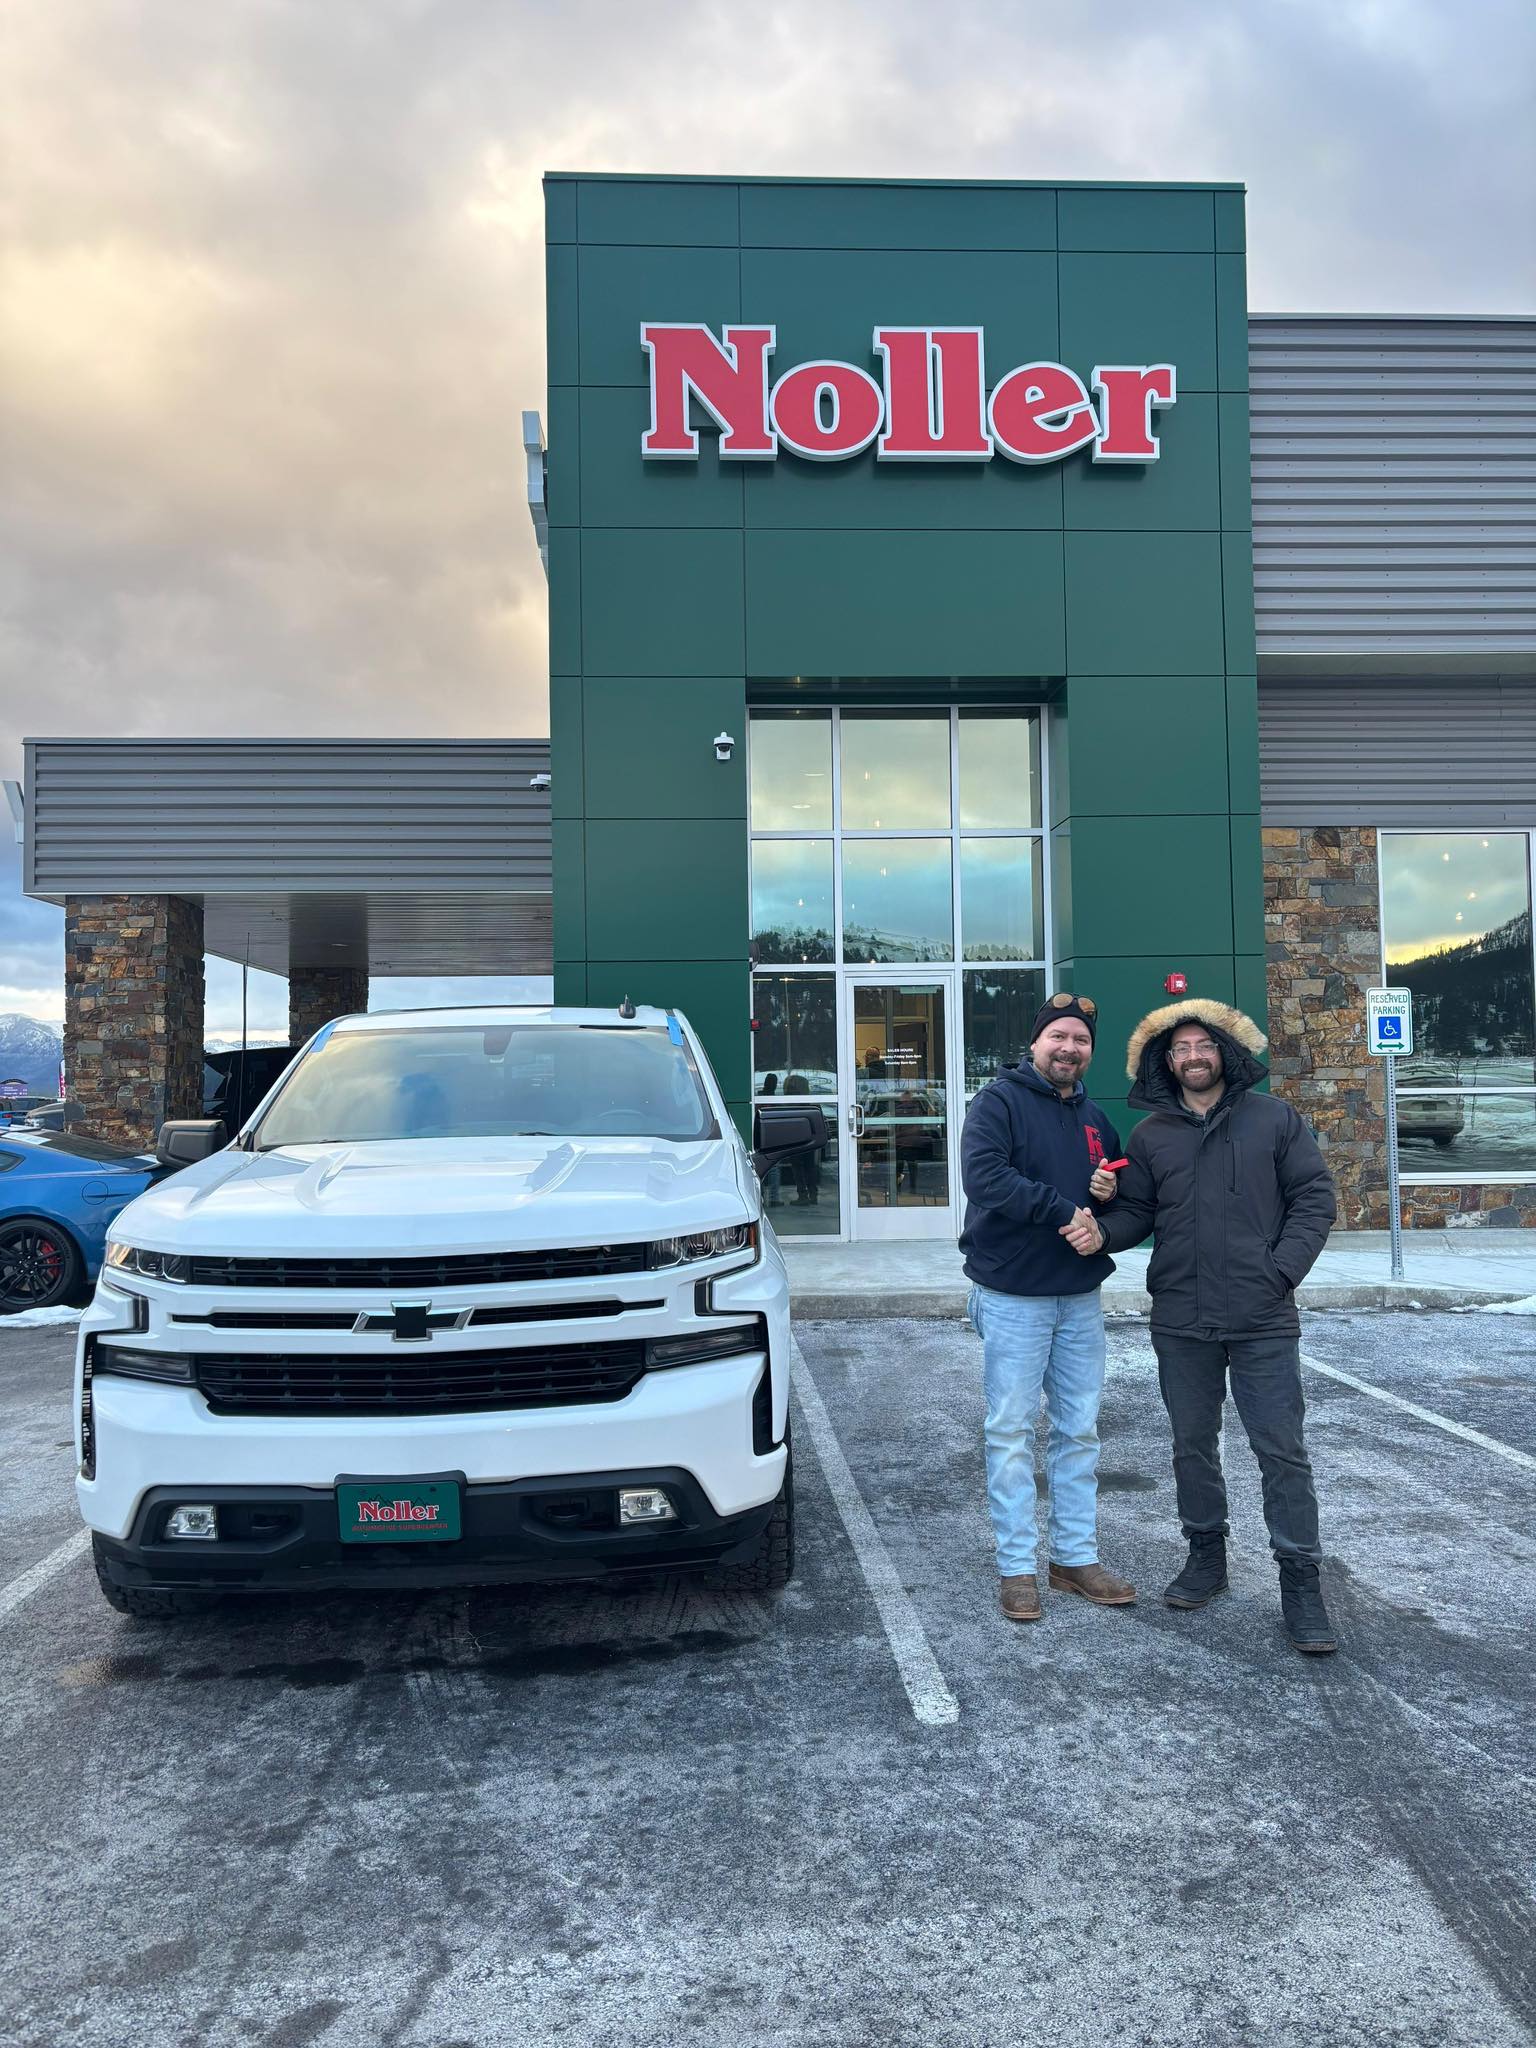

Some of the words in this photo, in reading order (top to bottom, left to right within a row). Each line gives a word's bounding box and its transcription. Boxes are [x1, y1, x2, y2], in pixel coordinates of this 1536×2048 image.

[640, 321, 1177, 465] Noller
[1370, 994, 1408, 1003] RESERVED
[1372, 1005, 1406, 1015] PARKING
[357, 1500, 440, 1522] Noller
